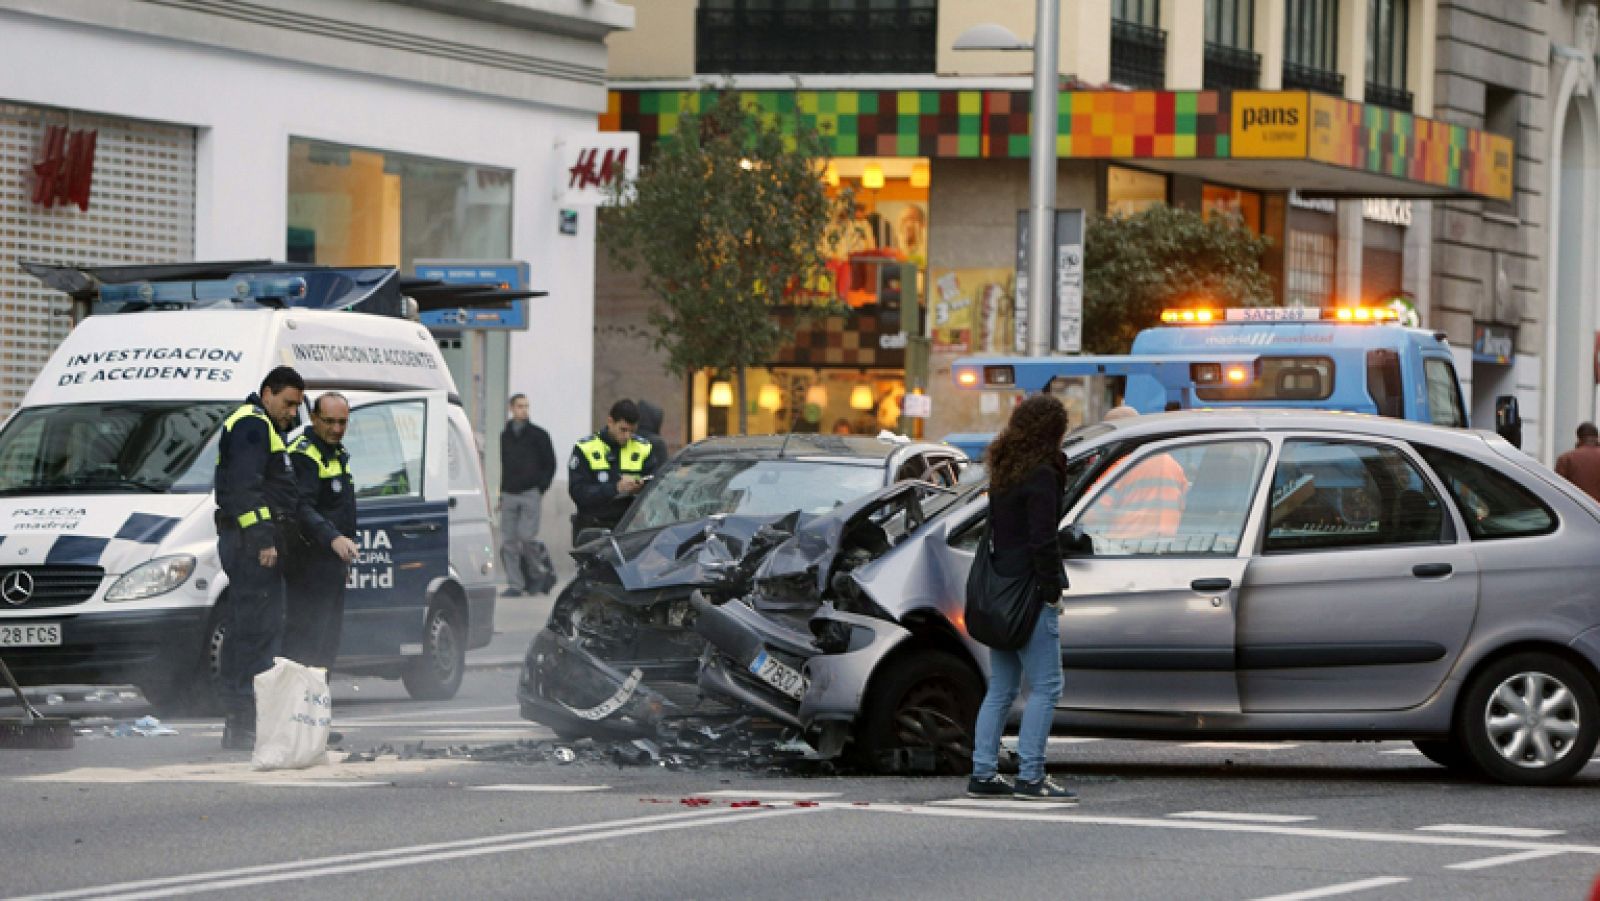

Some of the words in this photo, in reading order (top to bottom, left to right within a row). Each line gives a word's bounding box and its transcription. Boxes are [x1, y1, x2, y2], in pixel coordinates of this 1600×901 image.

[1242, 107, 1299, 132] pans
[568, 147, 628, 190] H&M
[66, 347, 243, 368] INVESTIGACION
[291, 343, 369, 362] INVESTIGACION
[369, 347, 383, 364] DE
[383, 348, 438, 369] ACCIDENTES
[58, 370, 88, 387] DE
[89, 366, 234, 383] ACCIDENTES
[27, 627, 57, 643] FCS
